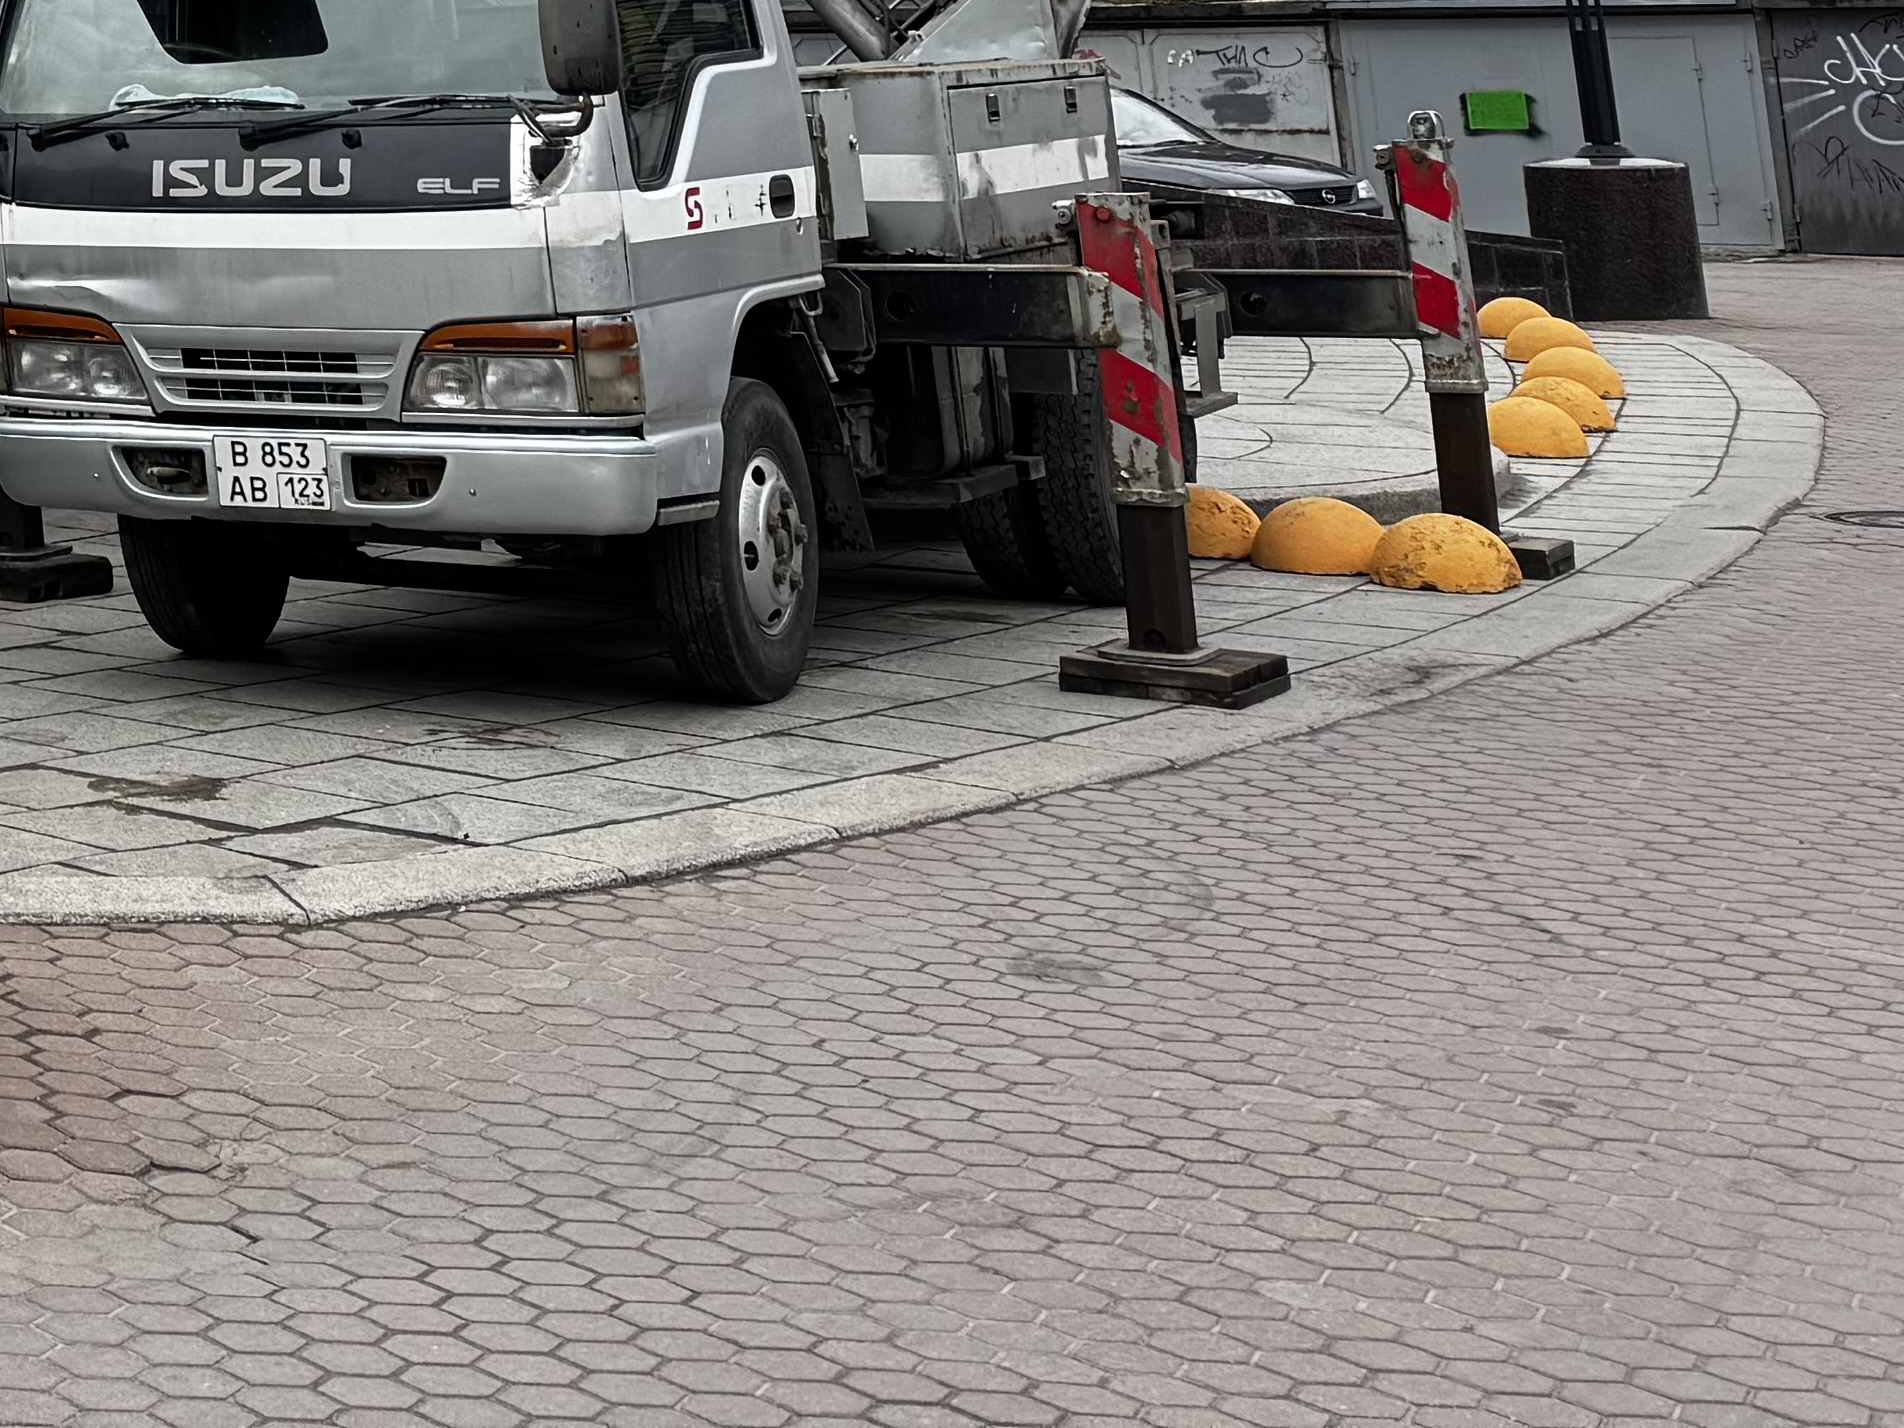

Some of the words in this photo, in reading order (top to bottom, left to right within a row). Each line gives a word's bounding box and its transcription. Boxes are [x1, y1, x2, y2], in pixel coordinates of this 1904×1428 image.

[152, 158, 352, 198] ISUZU
[417, 178, 501, 195] ELF
[230, 476, 268, 503] АВ
[284, 476, 324, 499] 123
